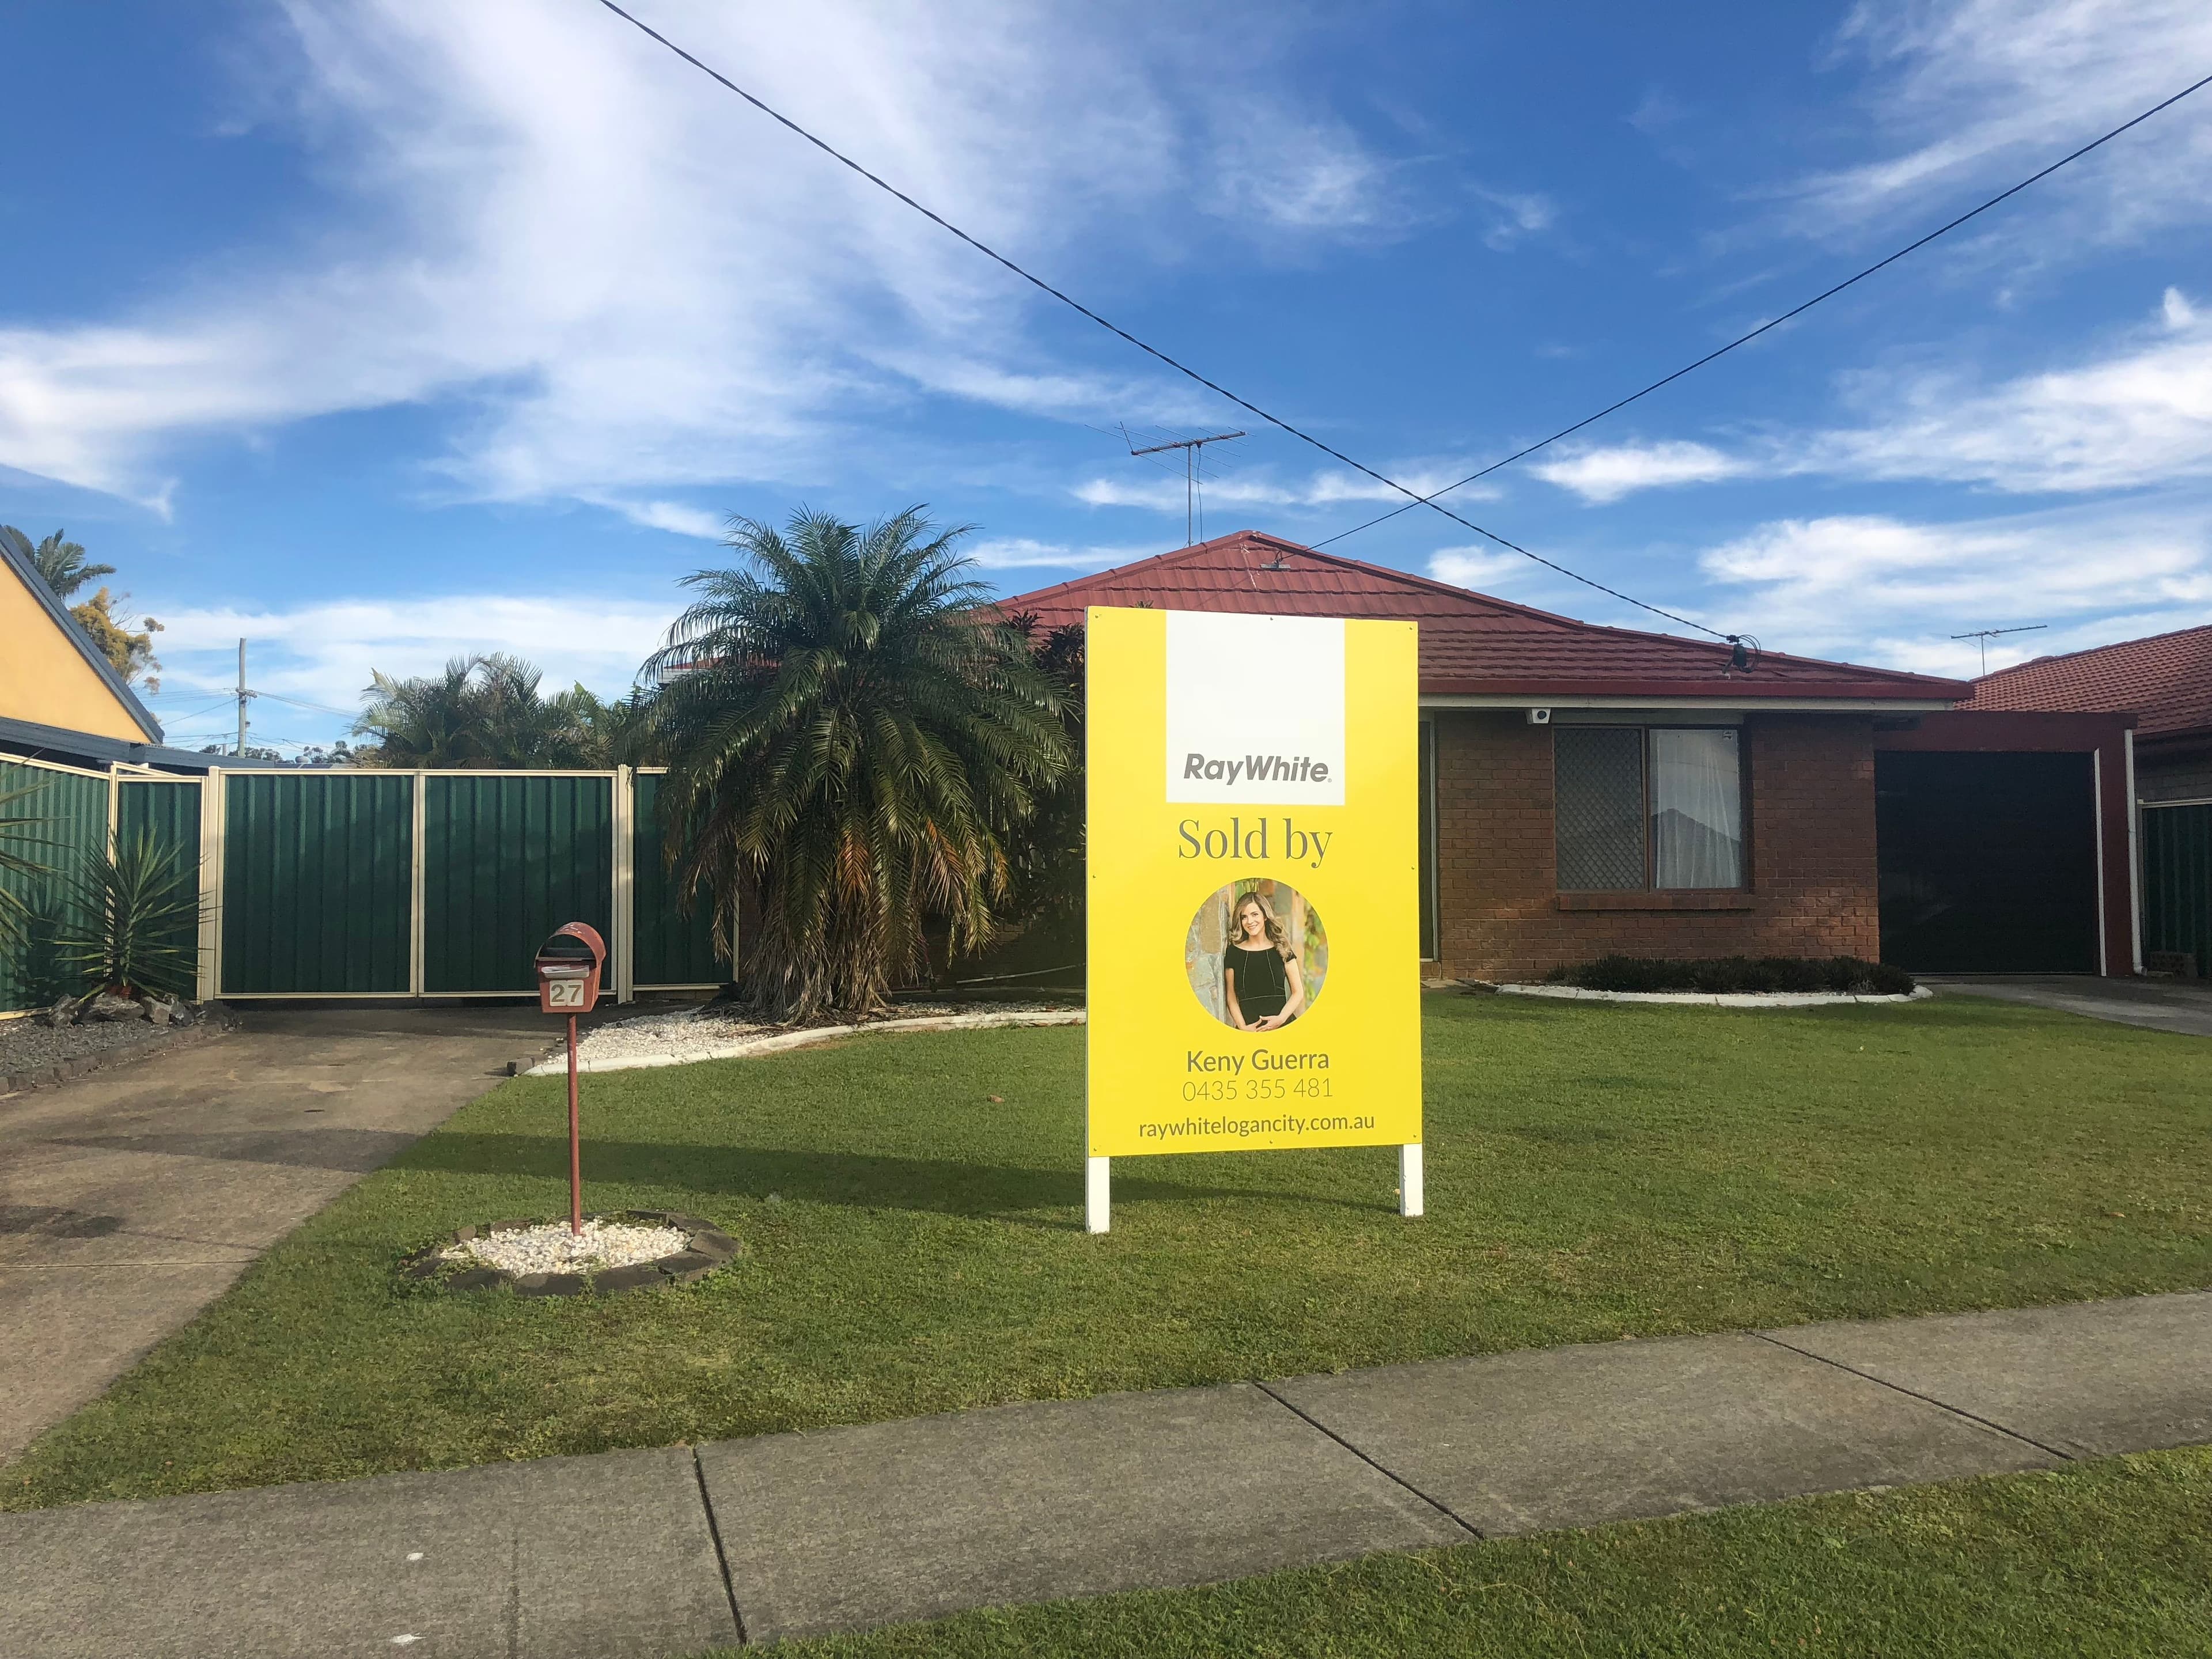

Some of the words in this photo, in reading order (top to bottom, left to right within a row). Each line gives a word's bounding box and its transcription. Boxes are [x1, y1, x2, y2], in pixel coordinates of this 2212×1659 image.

[1179, 817, 1270, 859] Sold
[1283, 817, 1333, 869] by
[551, 984, 582, 1002] 27
[1187, 1050, 1245, 1075] Keny
[1251, 1048, 1330, 1071] Guerra
[1183, 1080, 1237, 1101] 0435
[1246, 1078, 1285, 1099] 355
[1293, 1077, 1333, 1097] 481
[1139, 1114, 1375, 1140] raywhitelogancity.com.au
